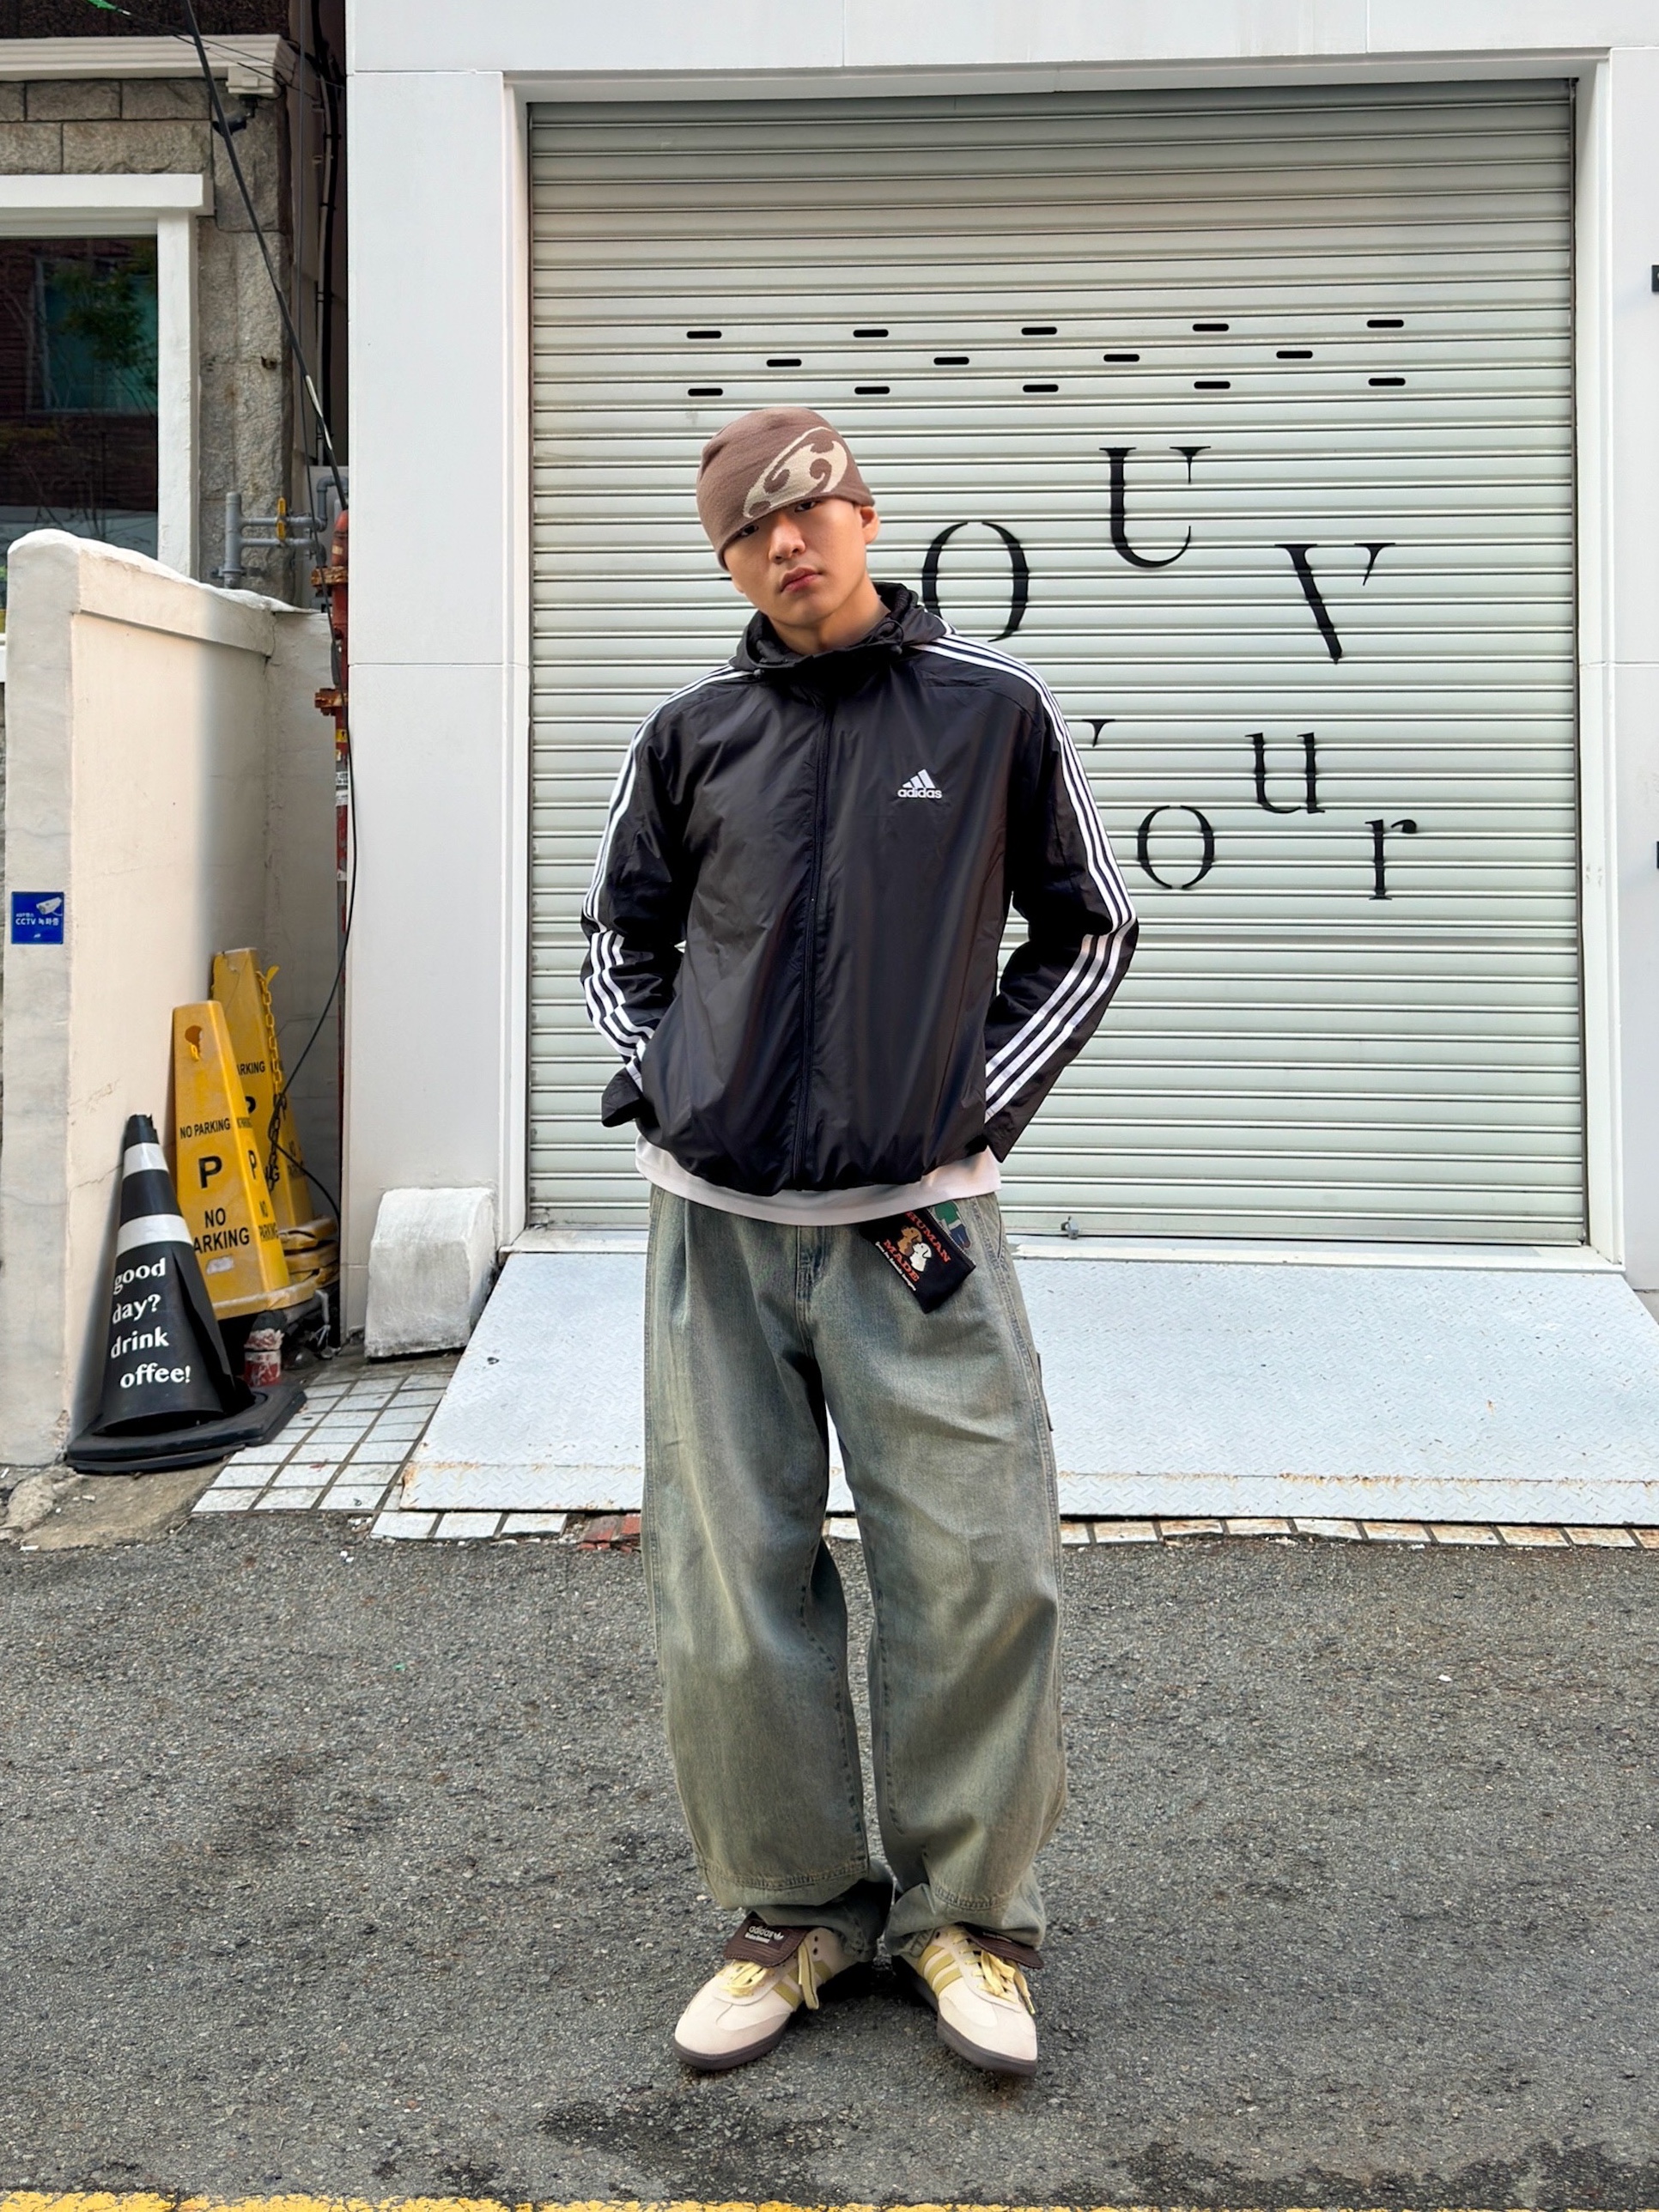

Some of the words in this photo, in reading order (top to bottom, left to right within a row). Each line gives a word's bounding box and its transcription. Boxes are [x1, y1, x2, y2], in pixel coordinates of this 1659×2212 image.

[897, 787, 943, 799] adidas
[179, 1125, 192, 1139] NO
[194, 1117, 231, 1137] PARKING
[198, 1155, 222, 1188] P
[247, 1150, 257, 1180] P
[204, 1207, 226, 1229] NO
[906, 1210, 951, 1263] HUMAN
[112, 1256, 167, 1295] good
[883, 1238, 920, 1283] MADE
[112, 1293, 161, 1324] day?
[110, 1326, 170, 1359] drink
[119, 1362, 191, 1389] offee!
